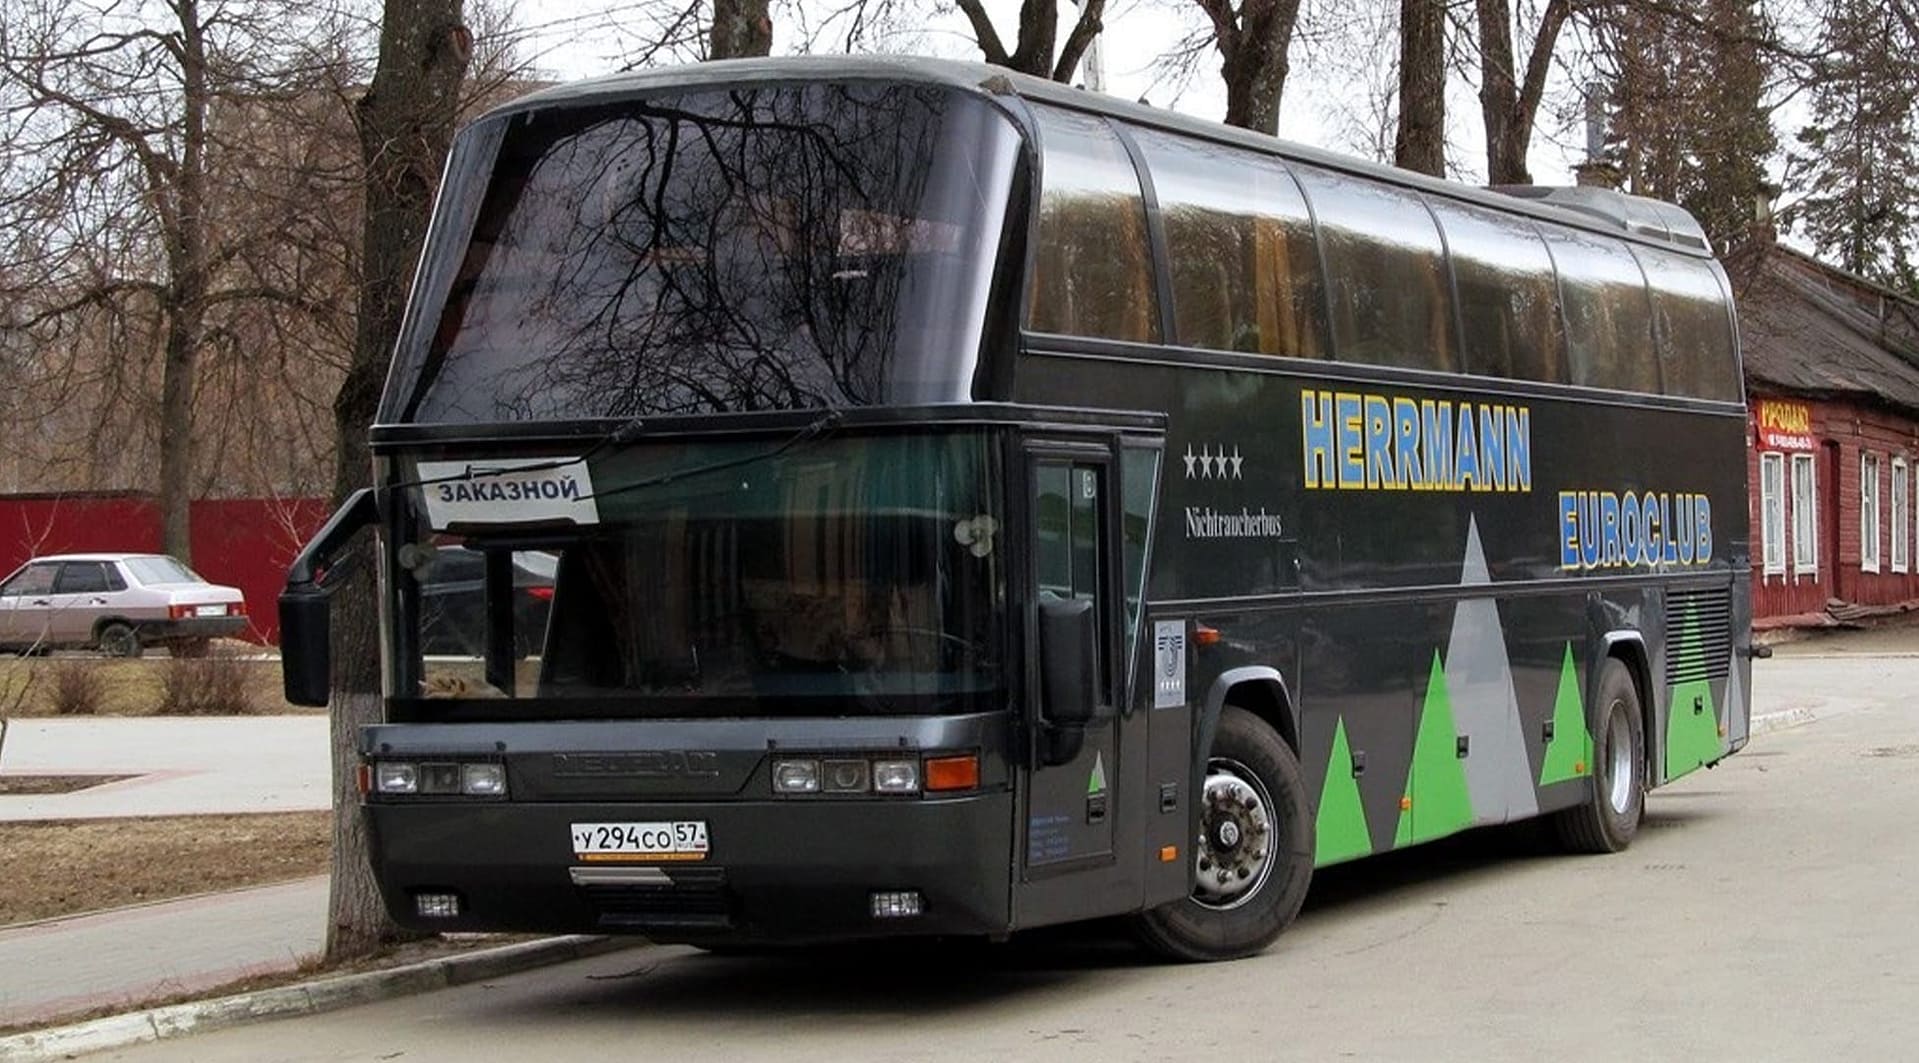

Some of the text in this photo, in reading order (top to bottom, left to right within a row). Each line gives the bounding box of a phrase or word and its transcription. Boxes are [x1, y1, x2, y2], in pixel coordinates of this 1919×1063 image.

[1301, 390, 1531, 491] HERRMANN
[438, 475, 580, 502] ЗАКАЗНОЙ
[1184, 506, 1282, 538] Nichtraucherbus
[1559, 490, 1712, 569] EUROCLUB
[675, 823, 698, 842] 57
